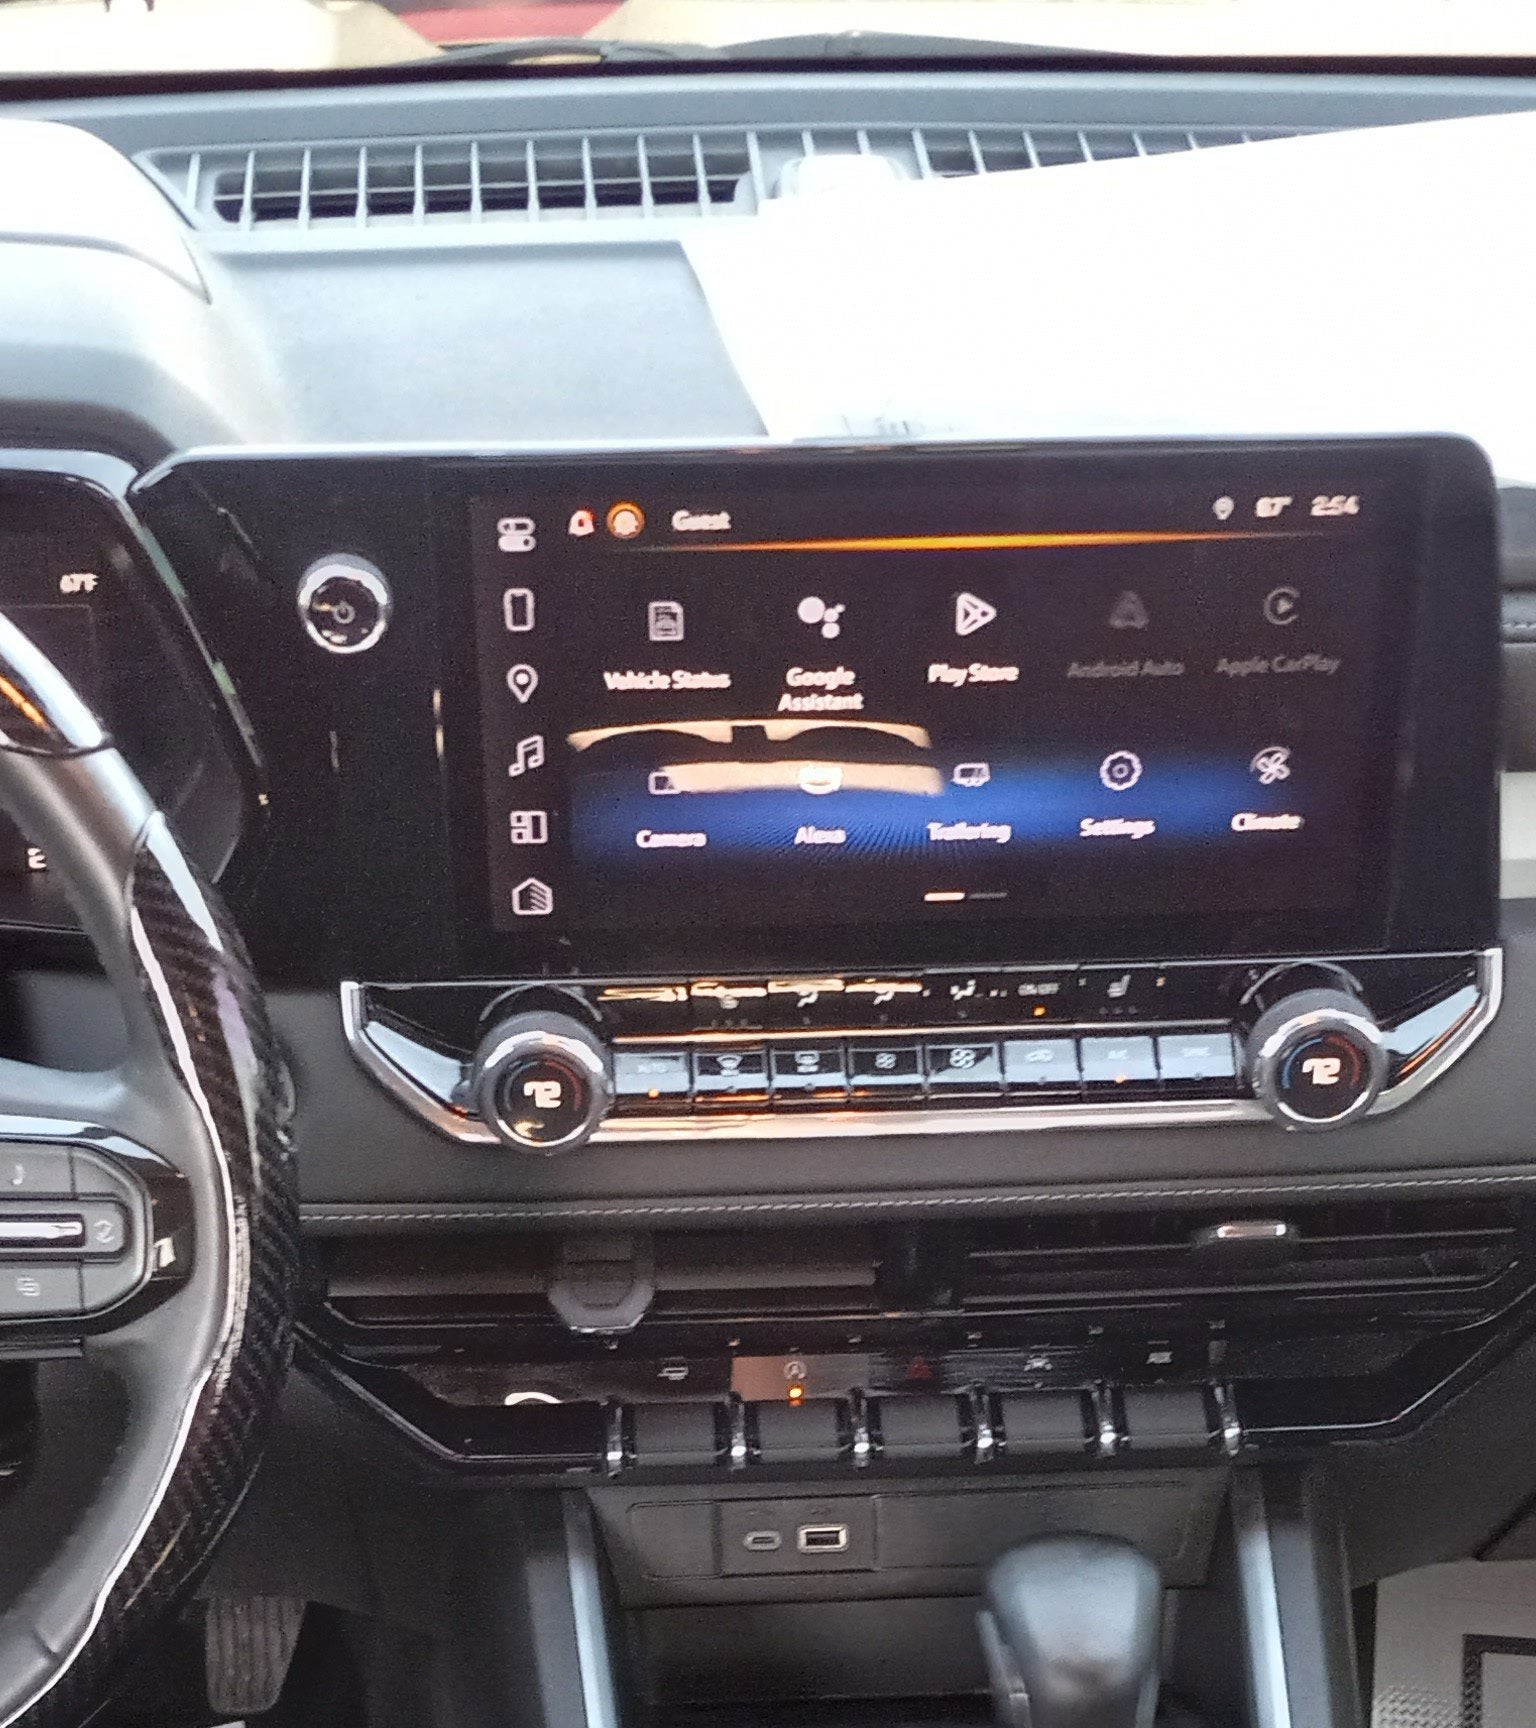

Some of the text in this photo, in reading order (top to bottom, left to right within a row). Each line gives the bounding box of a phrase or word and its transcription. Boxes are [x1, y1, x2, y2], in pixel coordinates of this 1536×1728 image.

[603, 670, 732, 691] Vehicle Status
[786, 666, 856, 690] Google
[927, 663, 1020, 687] Play Store
[777, 693, 864, 713] Assistant
[1079, 817, 1156, 840] Settings
[1231, 813, 1302, 832] Climate
[636, 830, 707, 848] Camera
